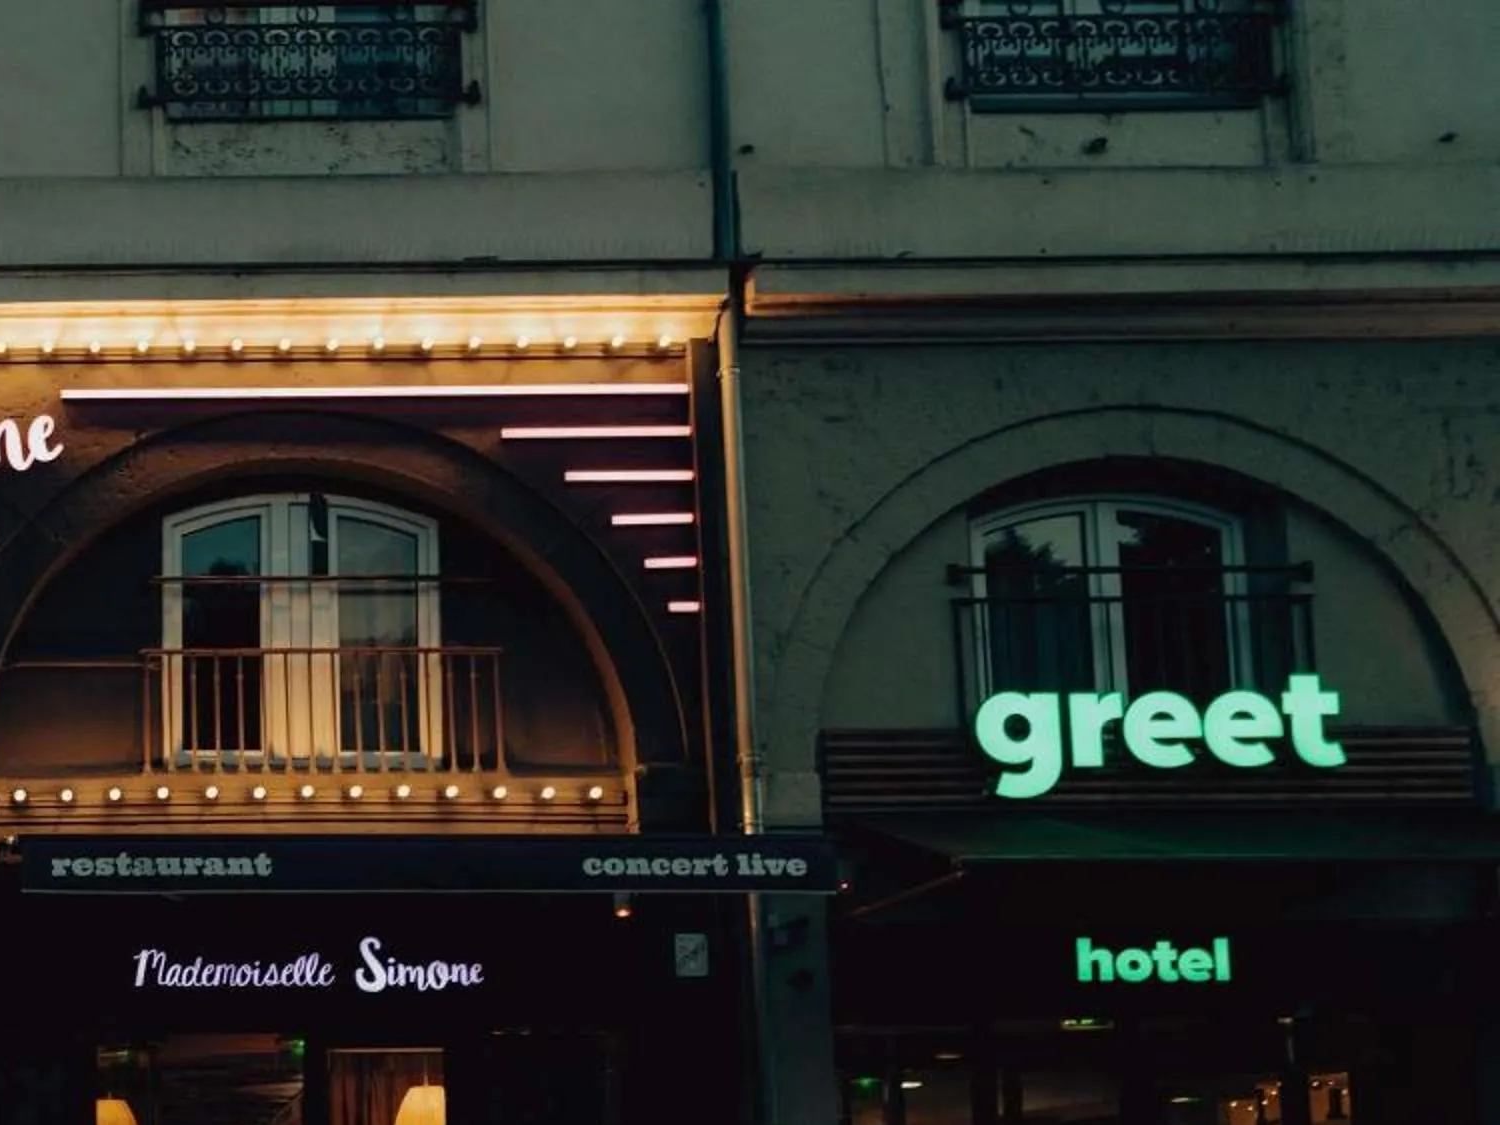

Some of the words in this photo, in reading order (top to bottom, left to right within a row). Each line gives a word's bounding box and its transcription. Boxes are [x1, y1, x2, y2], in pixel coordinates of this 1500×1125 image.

[975, 673, 1348, 799] greet
[51, 852, 272, 878] restaurant
[582, 853, 729, 877] concert
[736, 853, 807, 877] live
[133, 948, 336, 988] Mademoiselle
[354, 936, 485, 993] Simone
[1075, 936, 1232, 982] hotel
